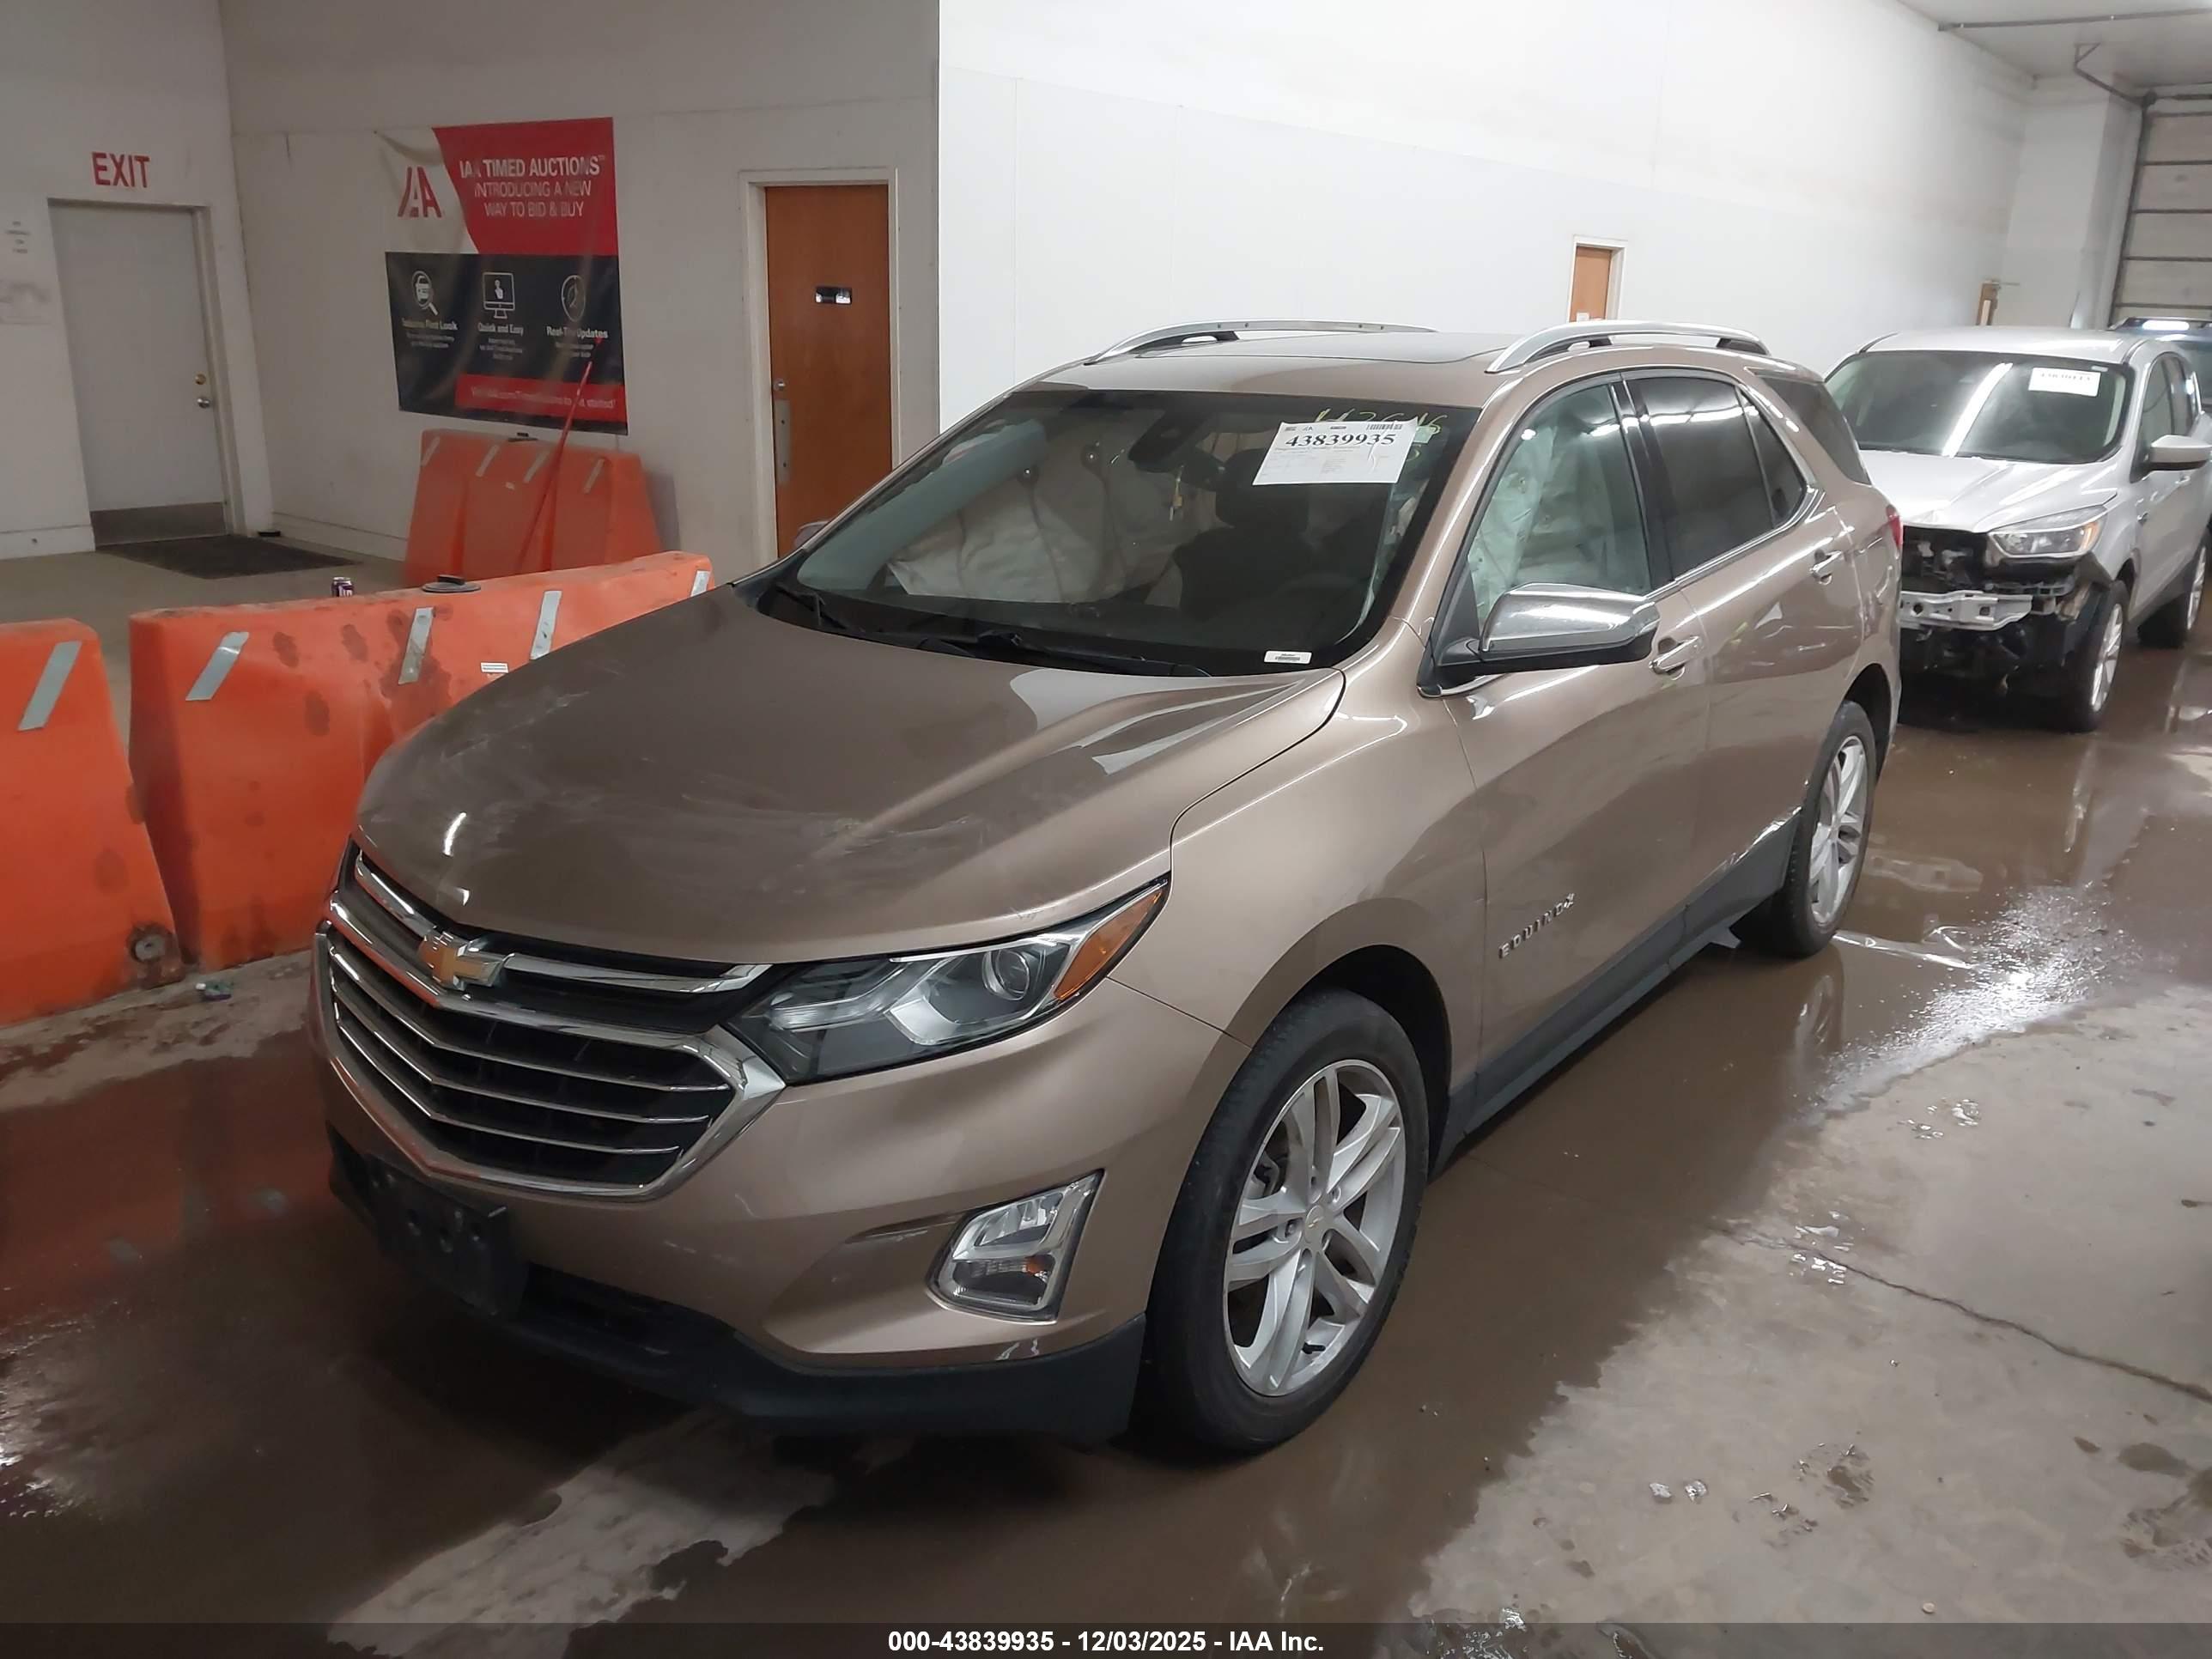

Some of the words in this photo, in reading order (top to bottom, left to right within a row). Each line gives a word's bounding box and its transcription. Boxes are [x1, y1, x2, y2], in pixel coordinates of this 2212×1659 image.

[91, 151, 150, 188] EXIT
[483, 158, 526, 178] TIMED
[474, 180, 550, 198] INTRODUCING
[554, 181, 562, 196] A
[564, 179, 591, 197] NEW
[484, 201, 507, 217] WAY
[508, 201, 525, 217] TO
[528, 201, 546, 216] BID
[560, 201, 585, 217] BUY
[1285, 433, 1397, 447] 43839935
